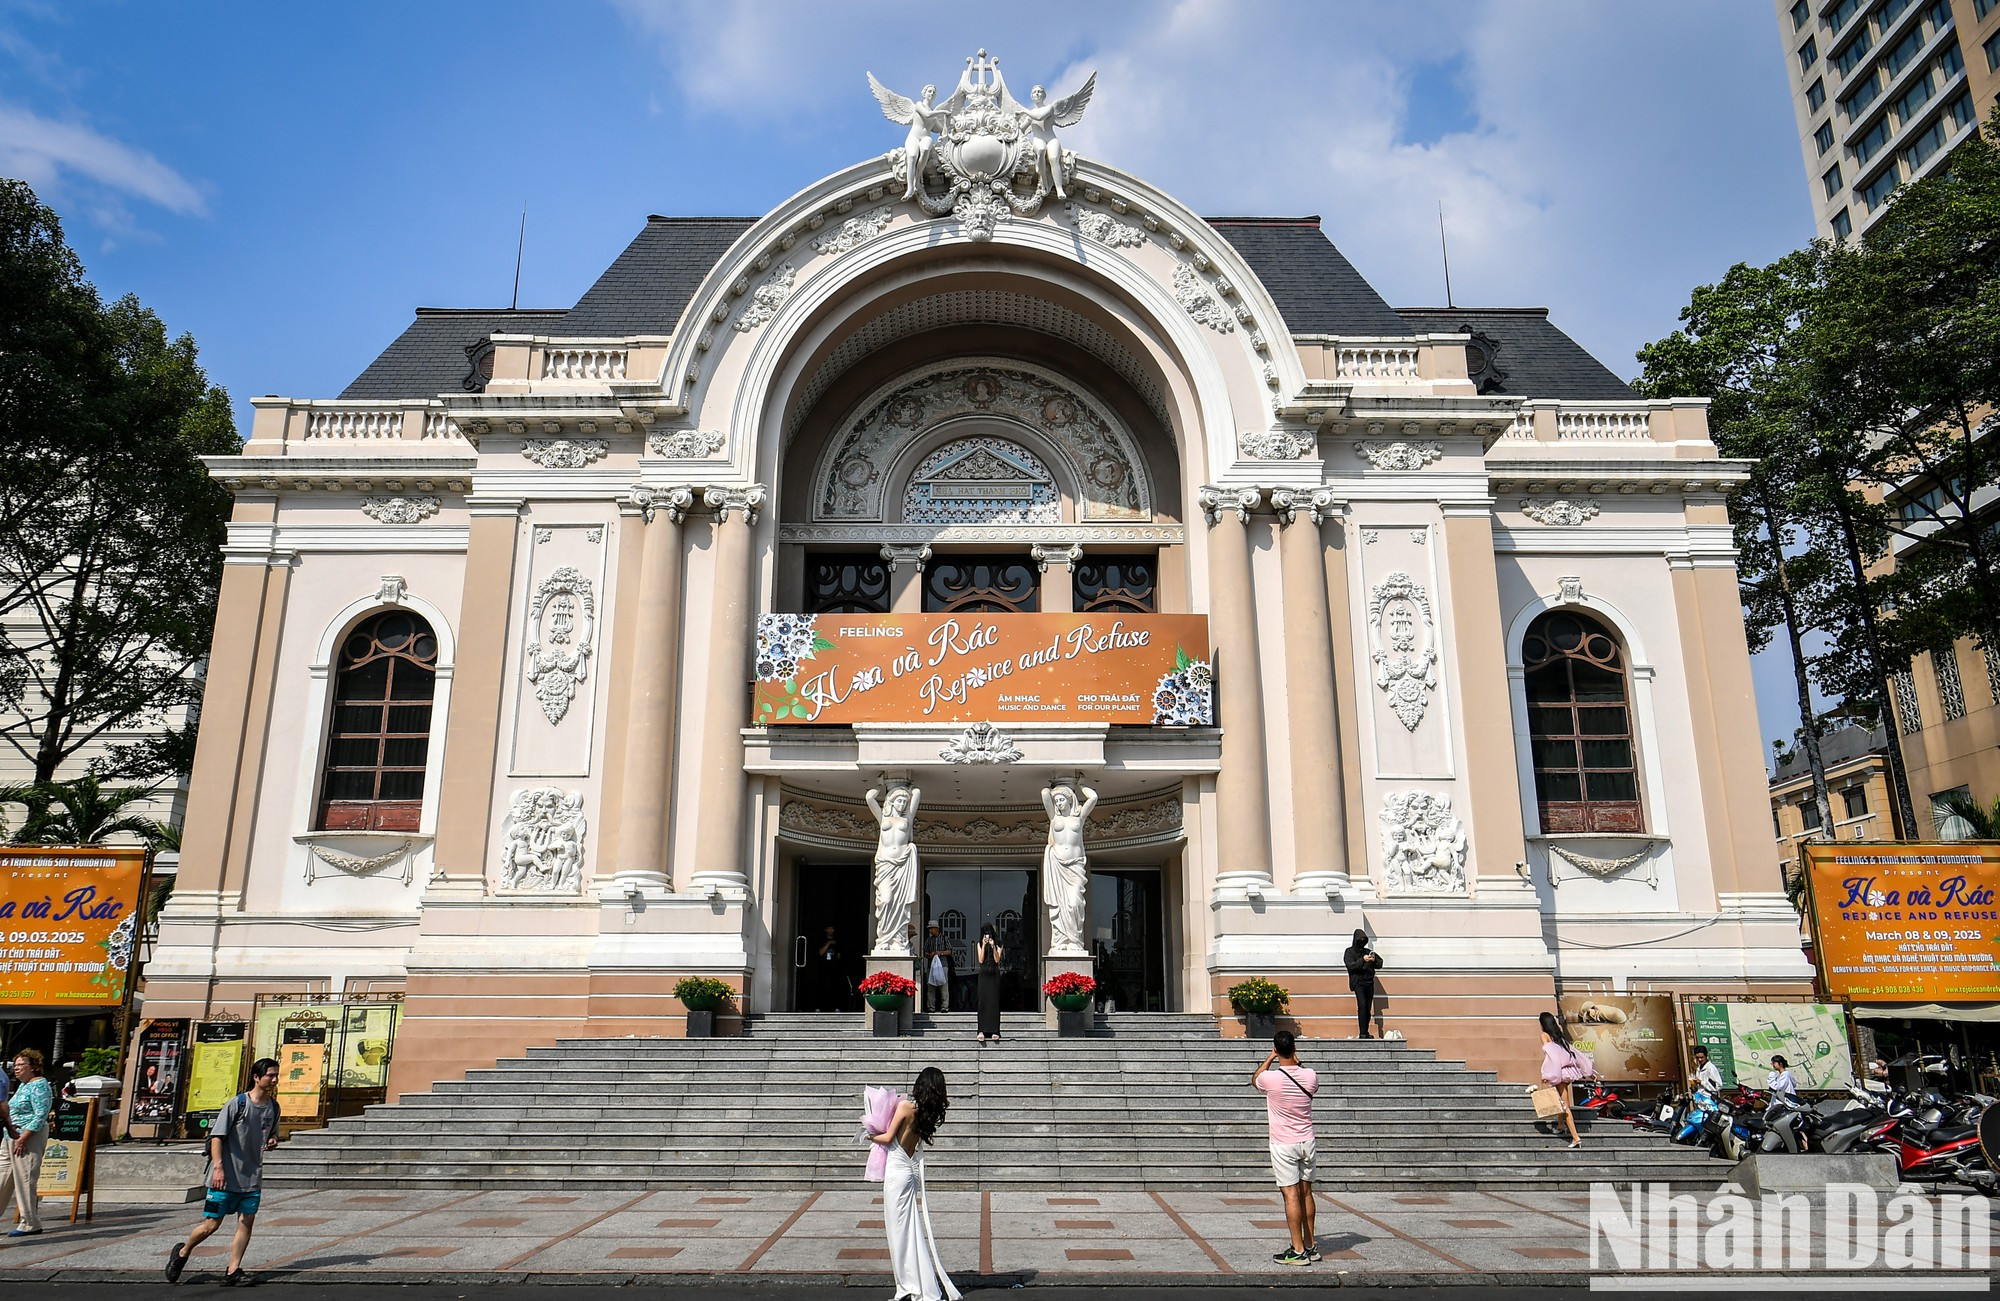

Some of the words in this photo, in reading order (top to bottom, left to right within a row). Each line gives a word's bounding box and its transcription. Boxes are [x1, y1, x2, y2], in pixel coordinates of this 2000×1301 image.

[839, 627, 904, 637] FEELINGS
[892, 645, 923, 677] và
[928, 618, 999, 667] Rác
[1019, 634, 1060, 670] and
[1065, 621, 1151, 660] Refuse
[998, 693, 1013, 702] ÂM
[1014, 695, 1040, 705] NHẠC
[1077, 694, 1097, 702] CHO
[1099, 693, 1121, 702] TRÁI
[1122, 692, 1141, 702] ĐẤT
[70, 858, 117, 868] FOUNDATION
[1835, 856, 1868, 865] FEELINGS
[1877, 856, 1899, 865] TRINH
[1901, 856, 1920, 865] CONG
[1921, 856, 1936, 865] SON
[1937, 855, 1983, 864] FOUNDATION
[1907, 885, 1931, 906] và
[1936, 875, 1995, 908] Rác
[21, 896, 51, 919] và
[53, 885, 124, 921] Rác
[1908, 911, 1938, 920] AND
[1944, 911, 1998, 920] REFUSE
[9, 931, 85, 943] 09.03.2025
[1866, 931, 1902, 940] March
[1904, 931, 1920, 940] 08
[1923, 931, 1931, 940] &
[1933, 931, 1952, 941] 09,
[1954, 931, 1982, 940] 2025
[9, 948, 24, 959] CHO
[26, 947, 43, 959] TRÁI
[40, 962, 55, 972] CHO
[1573, 1041, 1594, 1051] OW
